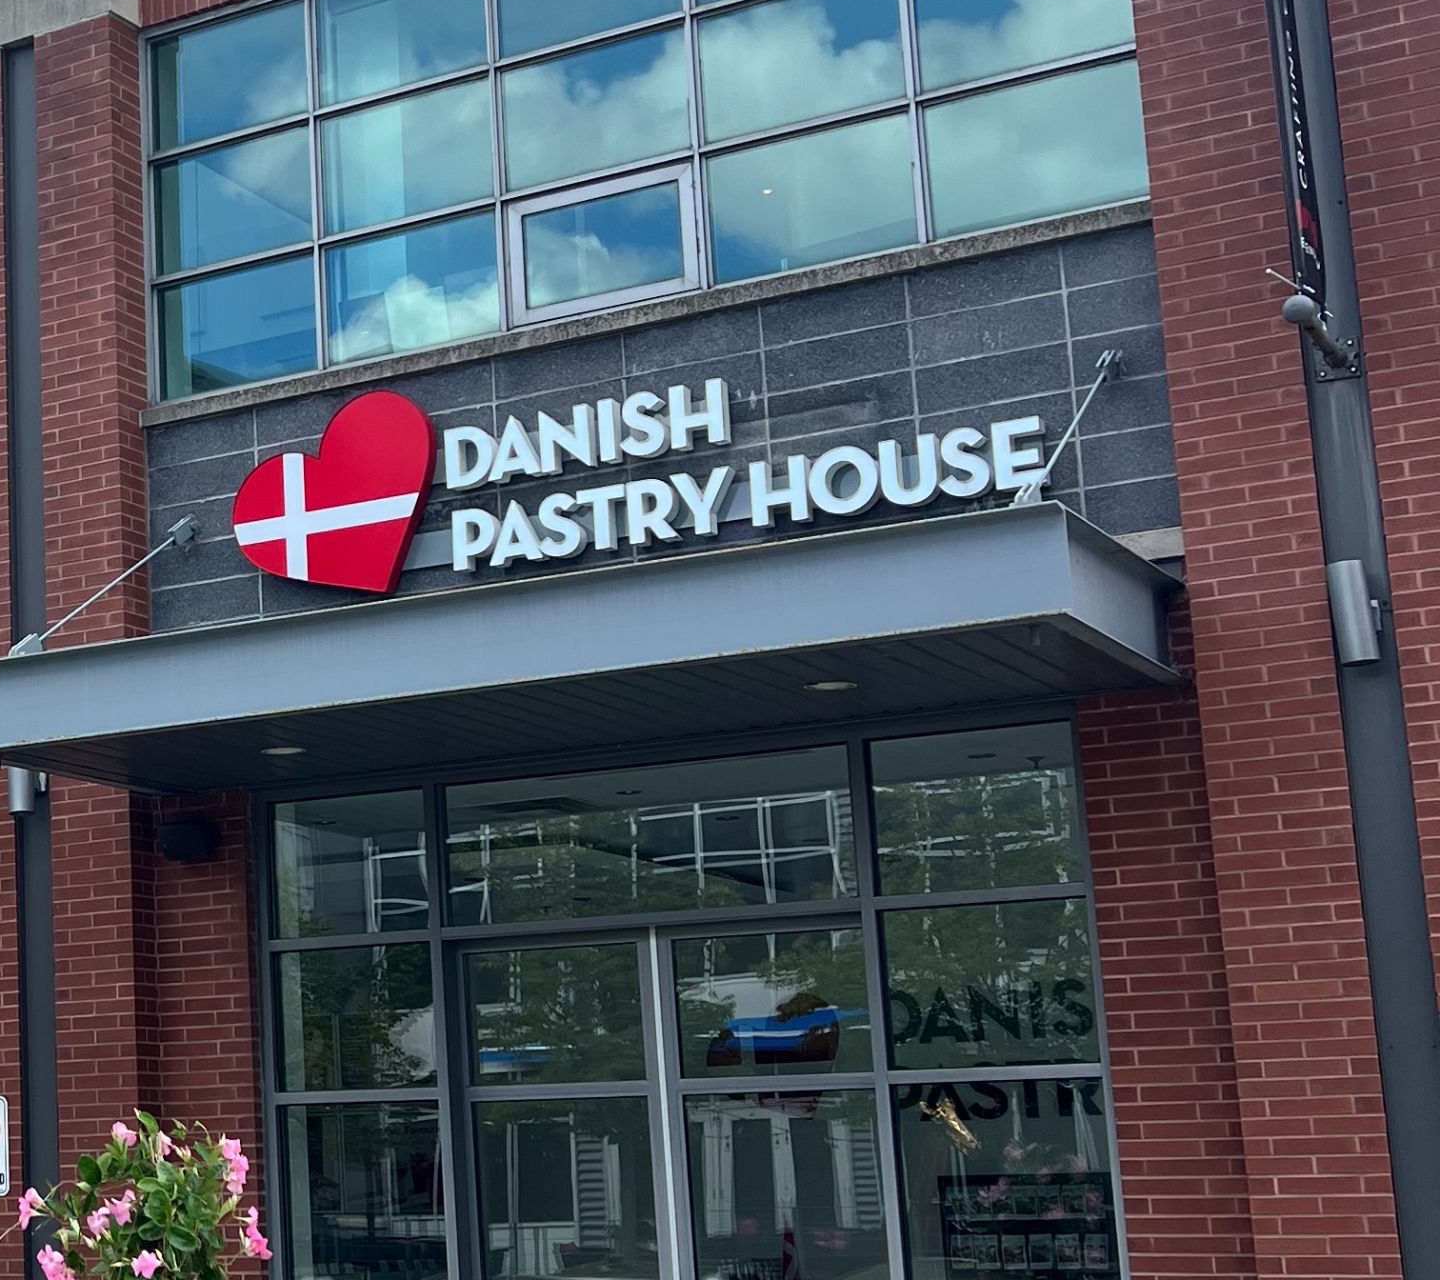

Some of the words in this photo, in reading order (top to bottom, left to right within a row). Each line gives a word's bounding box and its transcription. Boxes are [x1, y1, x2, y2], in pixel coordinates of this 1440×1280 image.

[444, 378, 731, 489] DANISH
[451, 466, 735, 571] PASTRY
[748, 415, 1048, 527] HOUSE
